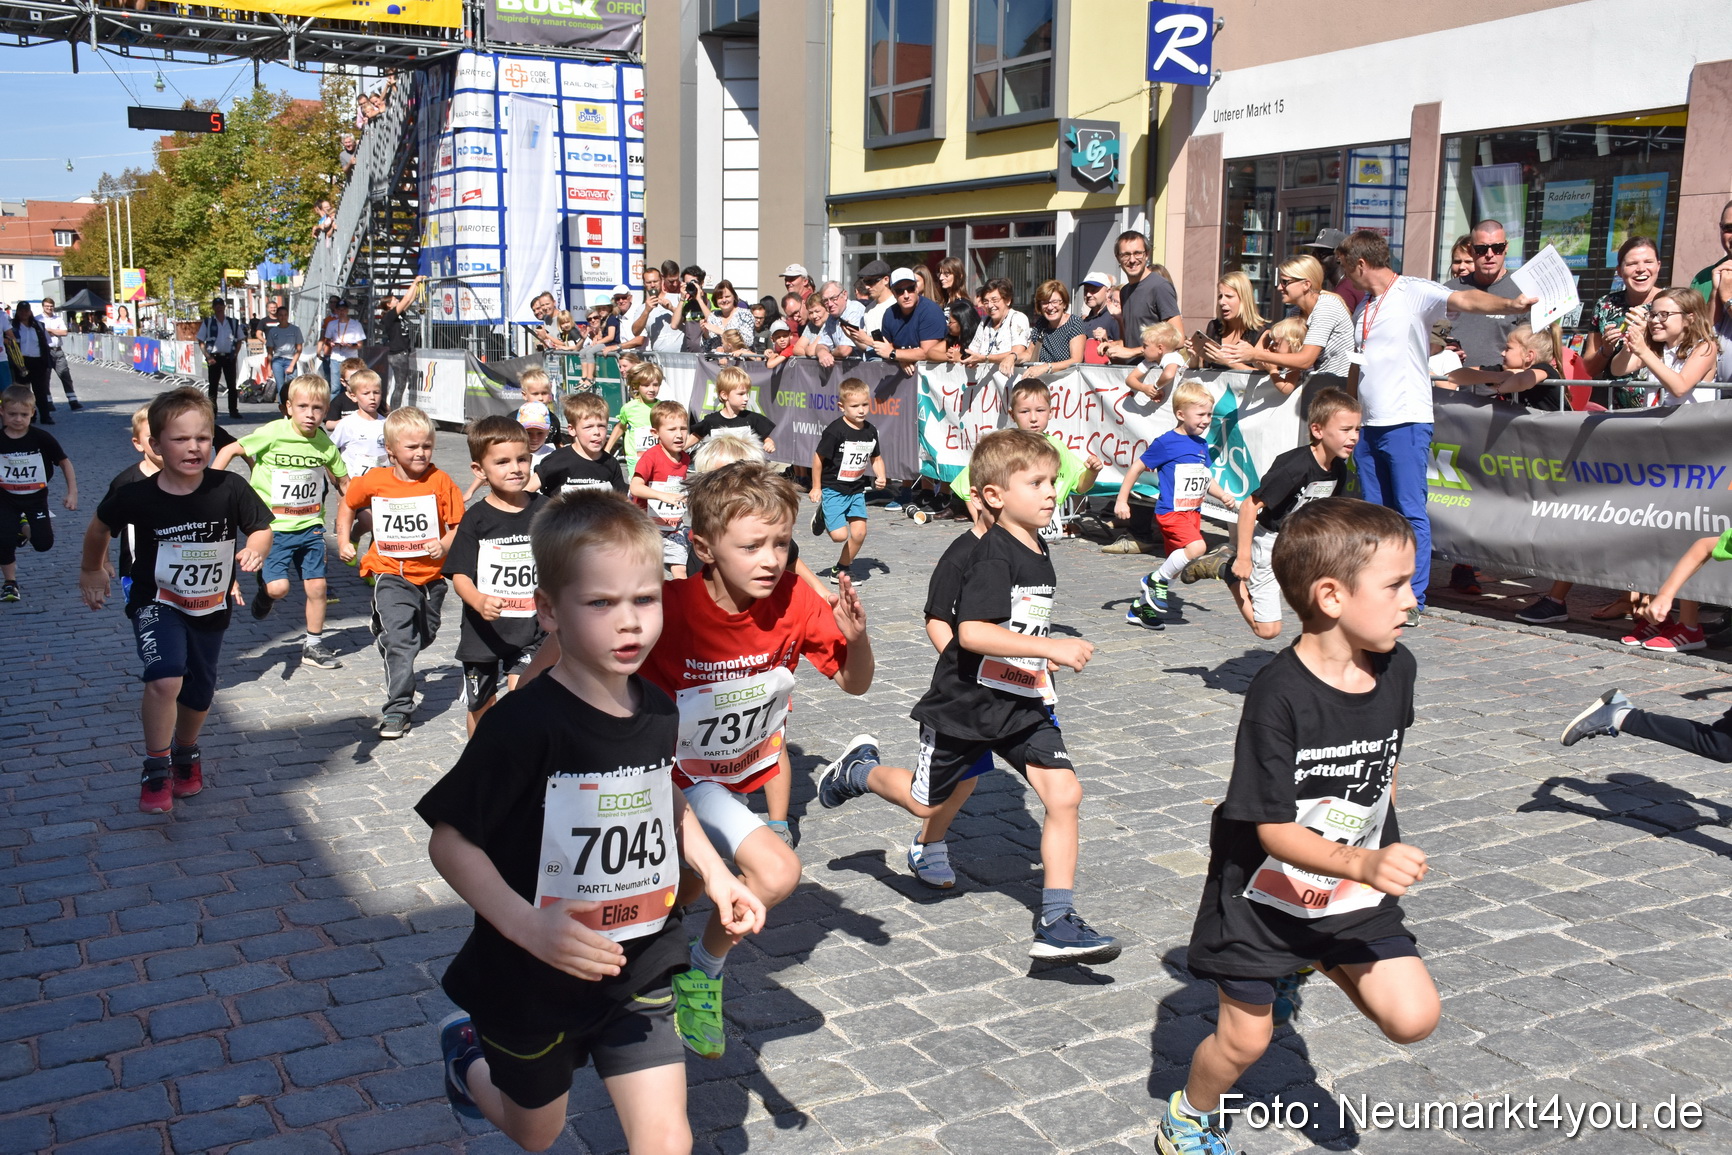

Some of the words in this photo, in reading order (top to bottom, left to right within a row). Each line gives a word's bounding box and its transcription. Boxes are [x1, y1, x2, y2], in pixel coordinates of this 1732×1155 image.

[496, 13, 528, 24] inspired
[530, 15, 540, 26] by
[543, 18, 566, 27] smart
[569, 20, 604, 30] concepts
[1213, 108, 1244, 123] Unterer
[1246, 102, 1271, 118] Markt
[1274, 99, 1285, 114] 15
[211, 114, 222, 132] 5
[1548, 191, 1590, 202] Radfahren
[776, 390, 806, 408] OFFICE
[4, 466, 37, 479] 7447
[1479, 453, 1566, 482] OFFICE
[1572, 460, 1726, 490] INDUSTRY
[280, 482, 316, 500] 7402
[284, 507, 312, 515] Benedikt
[382, 514, 428, 533] 7456
[182, 550, 218, 558] BOCK
[168, 562, 223, 587] 7375
[181, 598, 210, 608] Julian
[685, 653, 770, 672] Neumarkter
[714, 684, 766, 707] BOCK
[698, 696, 777, 746] 7377
[704, 748, 730, 757] PARTL
[710, 749, 760, 774] Valentin
[598, 788, 652, 811] BOCK
[571, 818, 666, 876] 7043
[546, 864, 560, 874] B2
[577, 884, 612, 894] PARTL
[614, 878, 651, 892] Neumarkt
[602, 904, 639, 926] Elias
